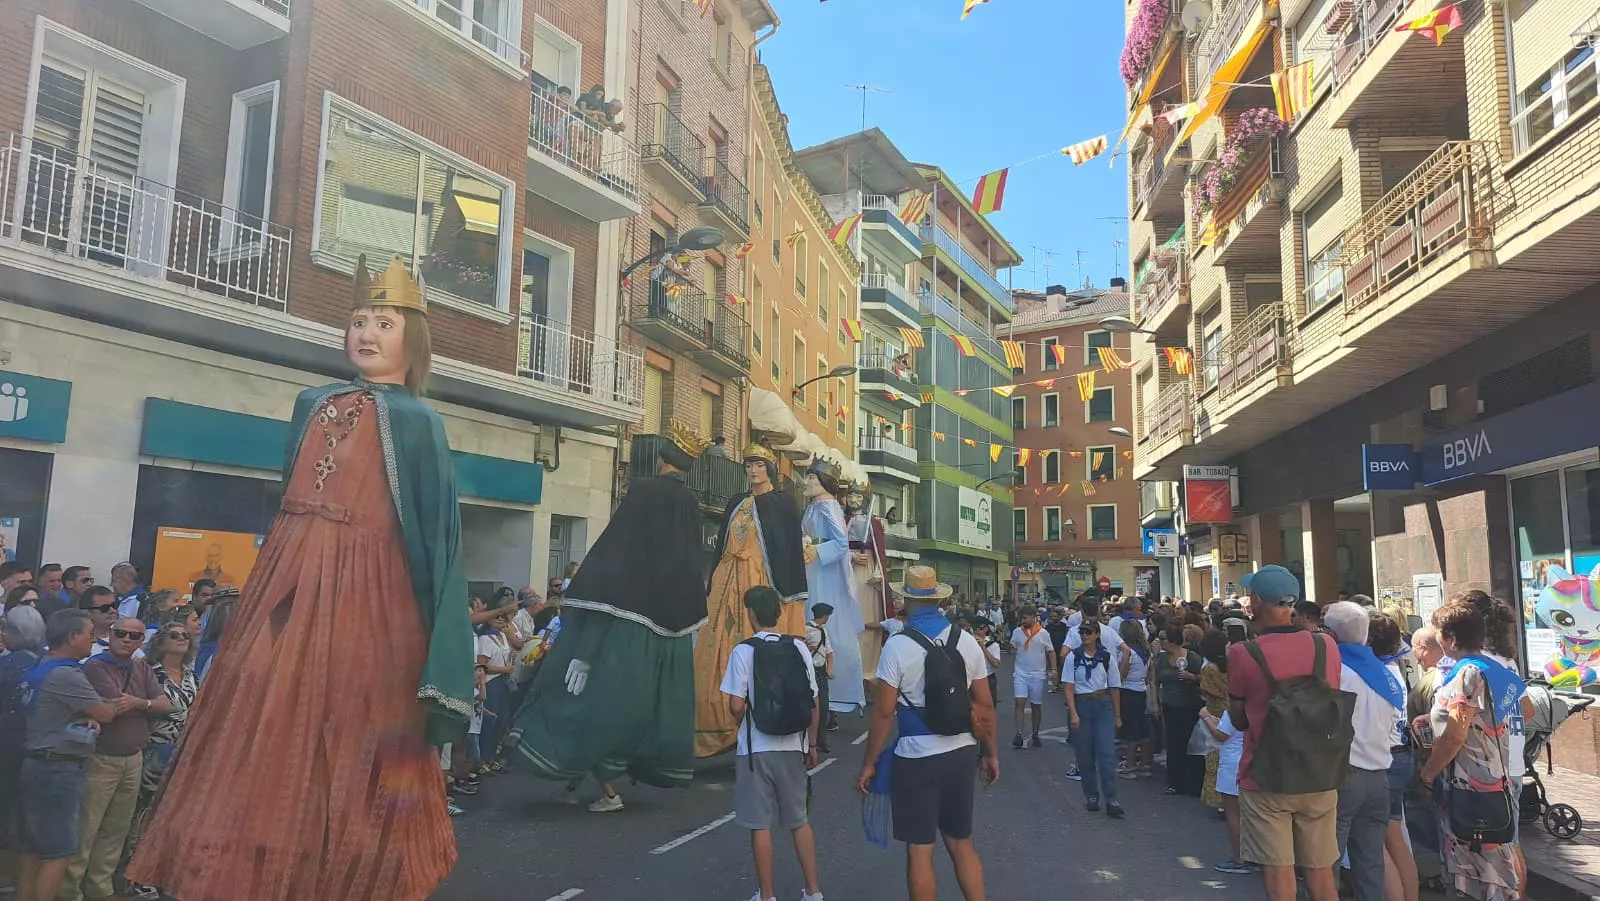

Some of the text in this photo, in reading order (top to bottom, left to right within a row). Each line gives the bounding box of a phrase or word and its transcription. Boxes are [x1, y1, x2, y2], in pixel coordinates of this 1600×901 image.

[1443, 428, 1492, 470] BBVA
[1188, 468, 1202, 476] BAR
[1370, 461, 1409, 473] BBVA
